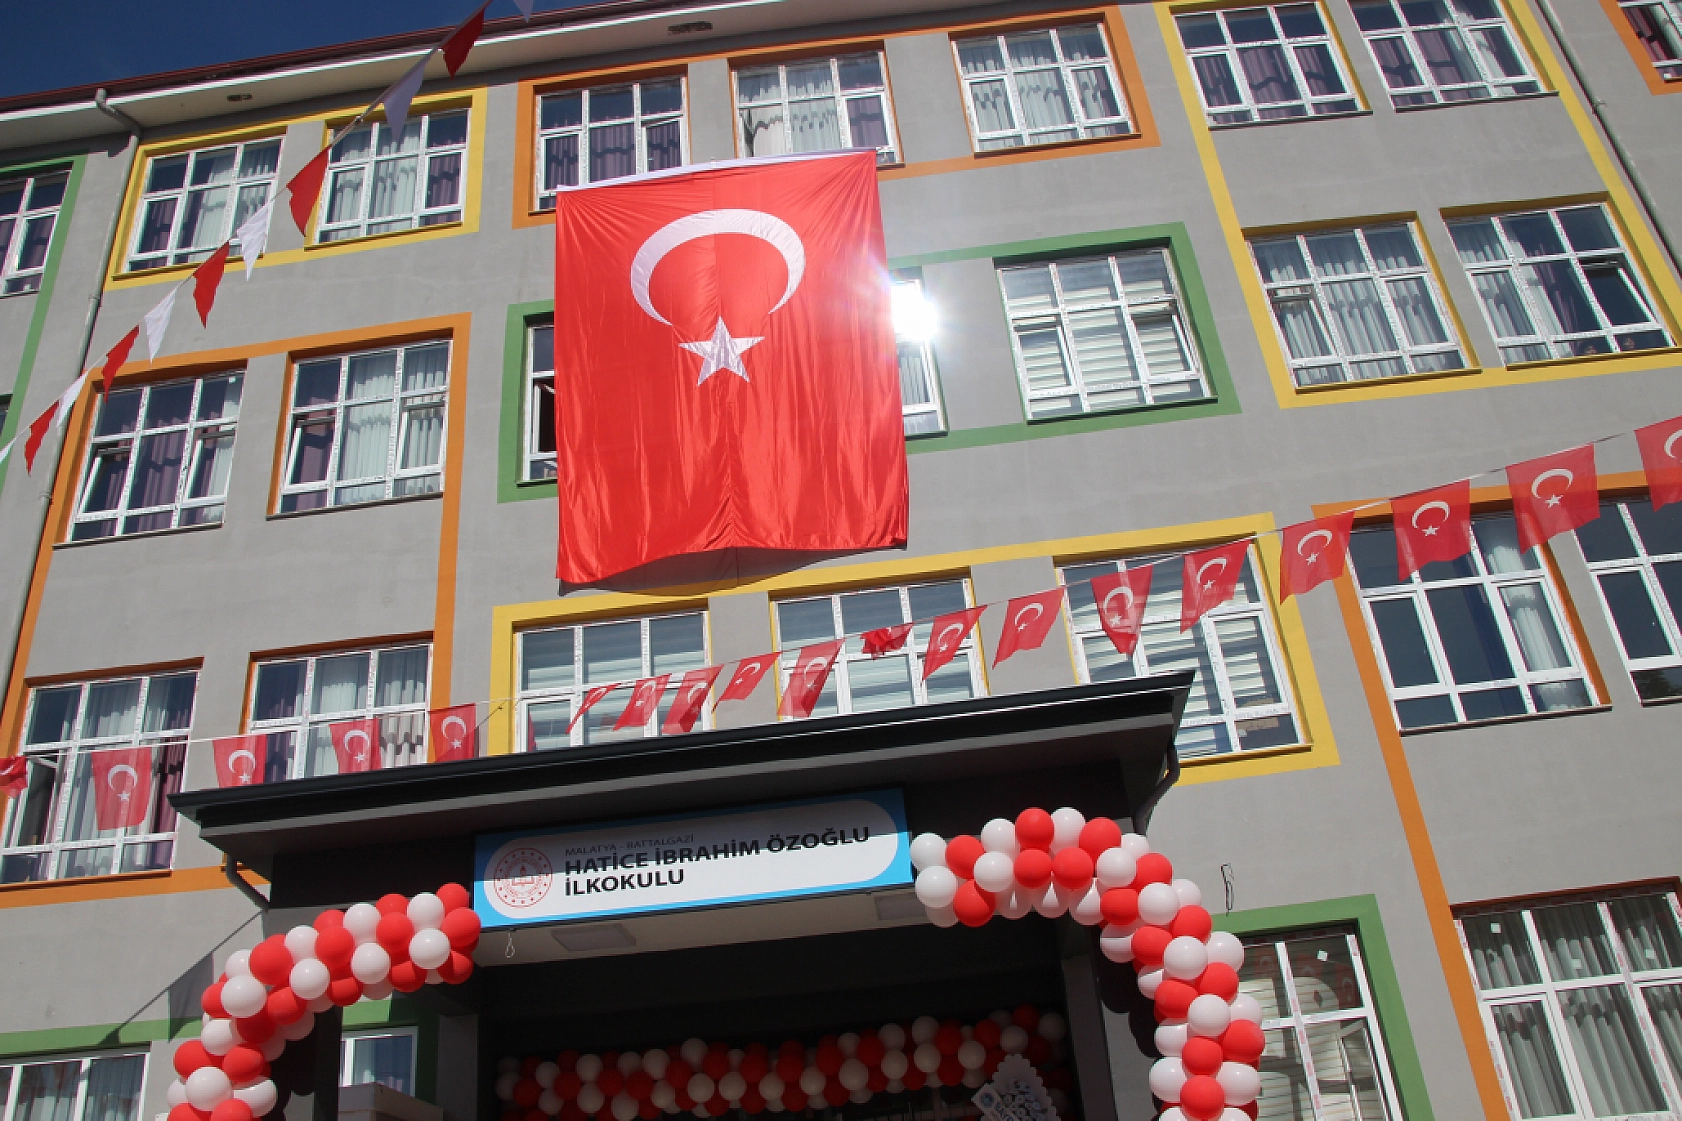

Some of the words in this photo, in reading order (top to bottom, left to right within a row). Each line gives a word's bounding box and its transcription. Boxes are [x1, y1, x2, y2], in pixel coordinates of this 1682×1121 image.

[565, 852, 649, 875] HATİCE
[655, 838, 761, 866] İBRAHİM
[767, 826, 870, 853] ÖZOĞLU
[565, 868, 684, 896] İLKOKULU
